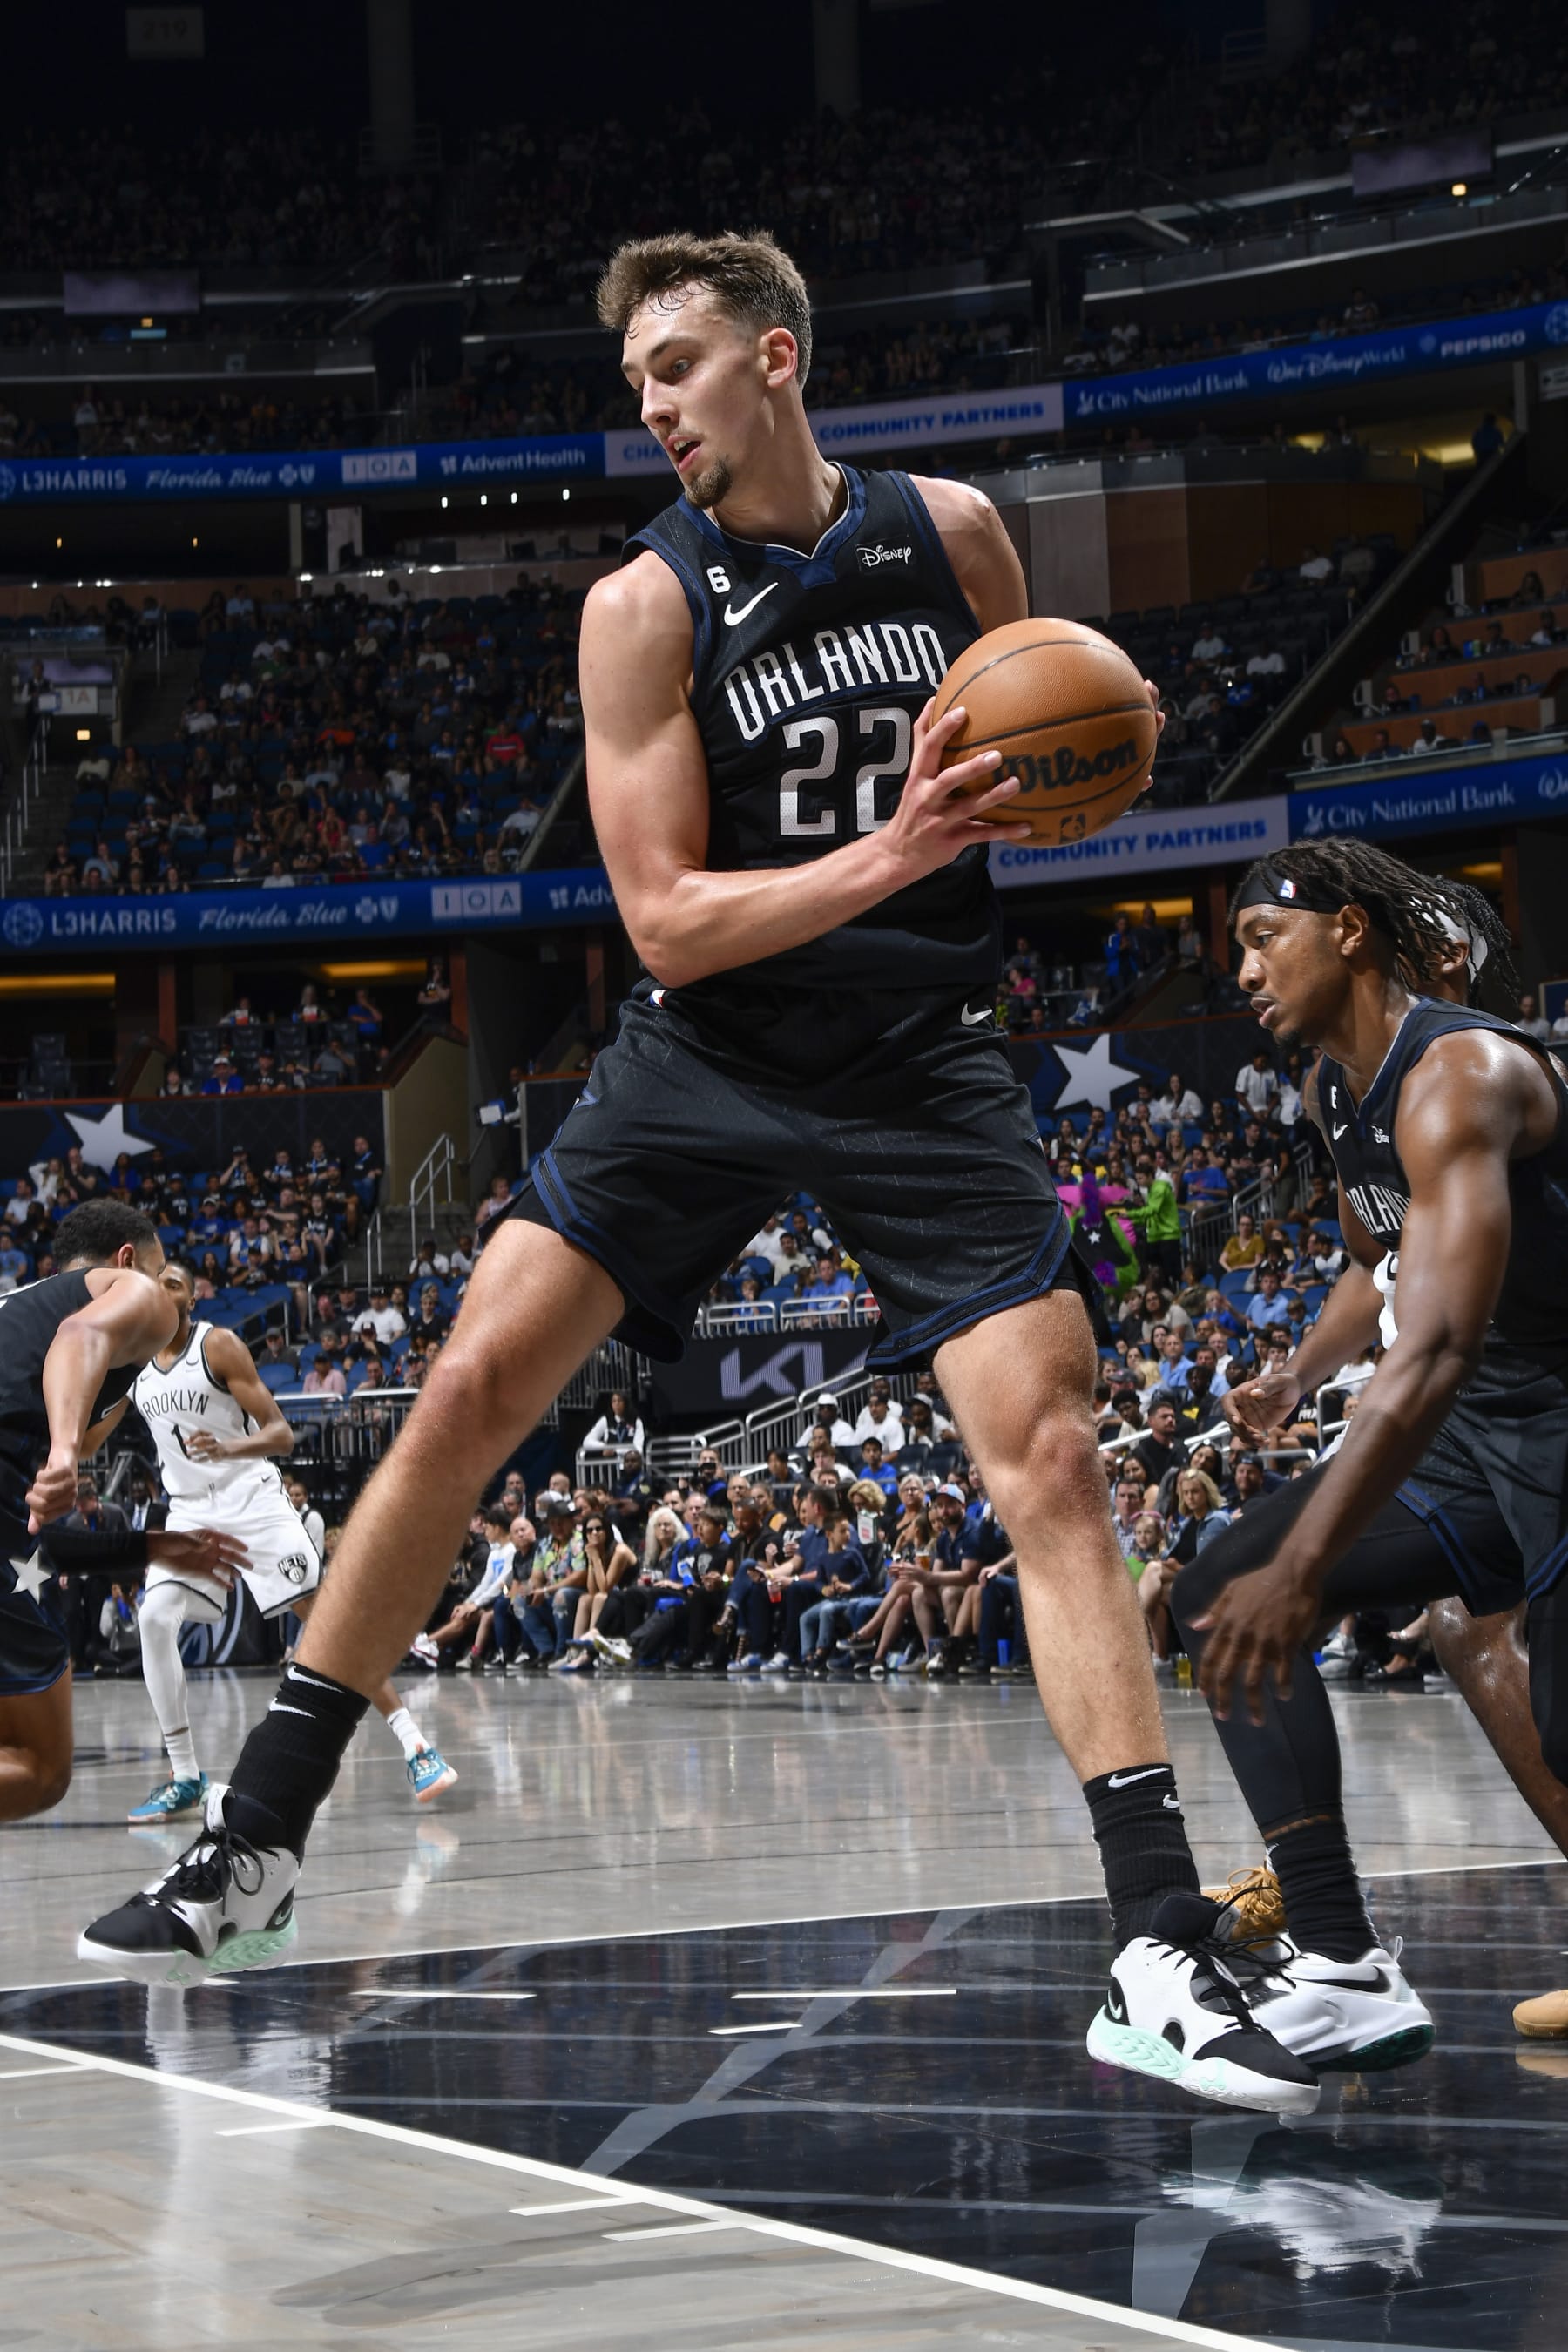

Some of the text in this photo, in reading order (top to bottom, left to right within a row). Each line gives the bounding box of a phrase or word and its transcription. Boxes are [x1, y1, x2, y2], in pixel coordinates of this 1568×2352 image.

[1098, 394, 1130, 412] City
[1133, 377, 1202, 405] National
[1206, 369, 1249, 395] Bank
[1441, 329, 1526, 358] PEPSICO
[22, 469, 128, 491] L3HARRIS
[146, 468, 222, 490] Florida
[228, 466, 271, 488] Blue
[819, 414, 935, 440] COMMUNITY
[942, 402, 1044, 427] PARTNERS
[706, 565, 731, 594] 6
[723, 623, 950, 741] ORLANDO
[780, 707, 911, 836] 22
[991, 739, 1139, 794] Wilson
[1328, 804, 1368, 829] City
[1372, 787, 1456, 823] National
[1461, 781, 1516, 812] Bank
[998, 820, 1267, 868] COMMUNITY PARTNERS
[51, 908, 177, 936] L3HARRIS
[199, 903, 290, 931] Florida
[295, 900, 347, 925] Blue
[142, 1389, 209, 1422] ROOKLYN
[280, 1553, 307, 1574] NETS
